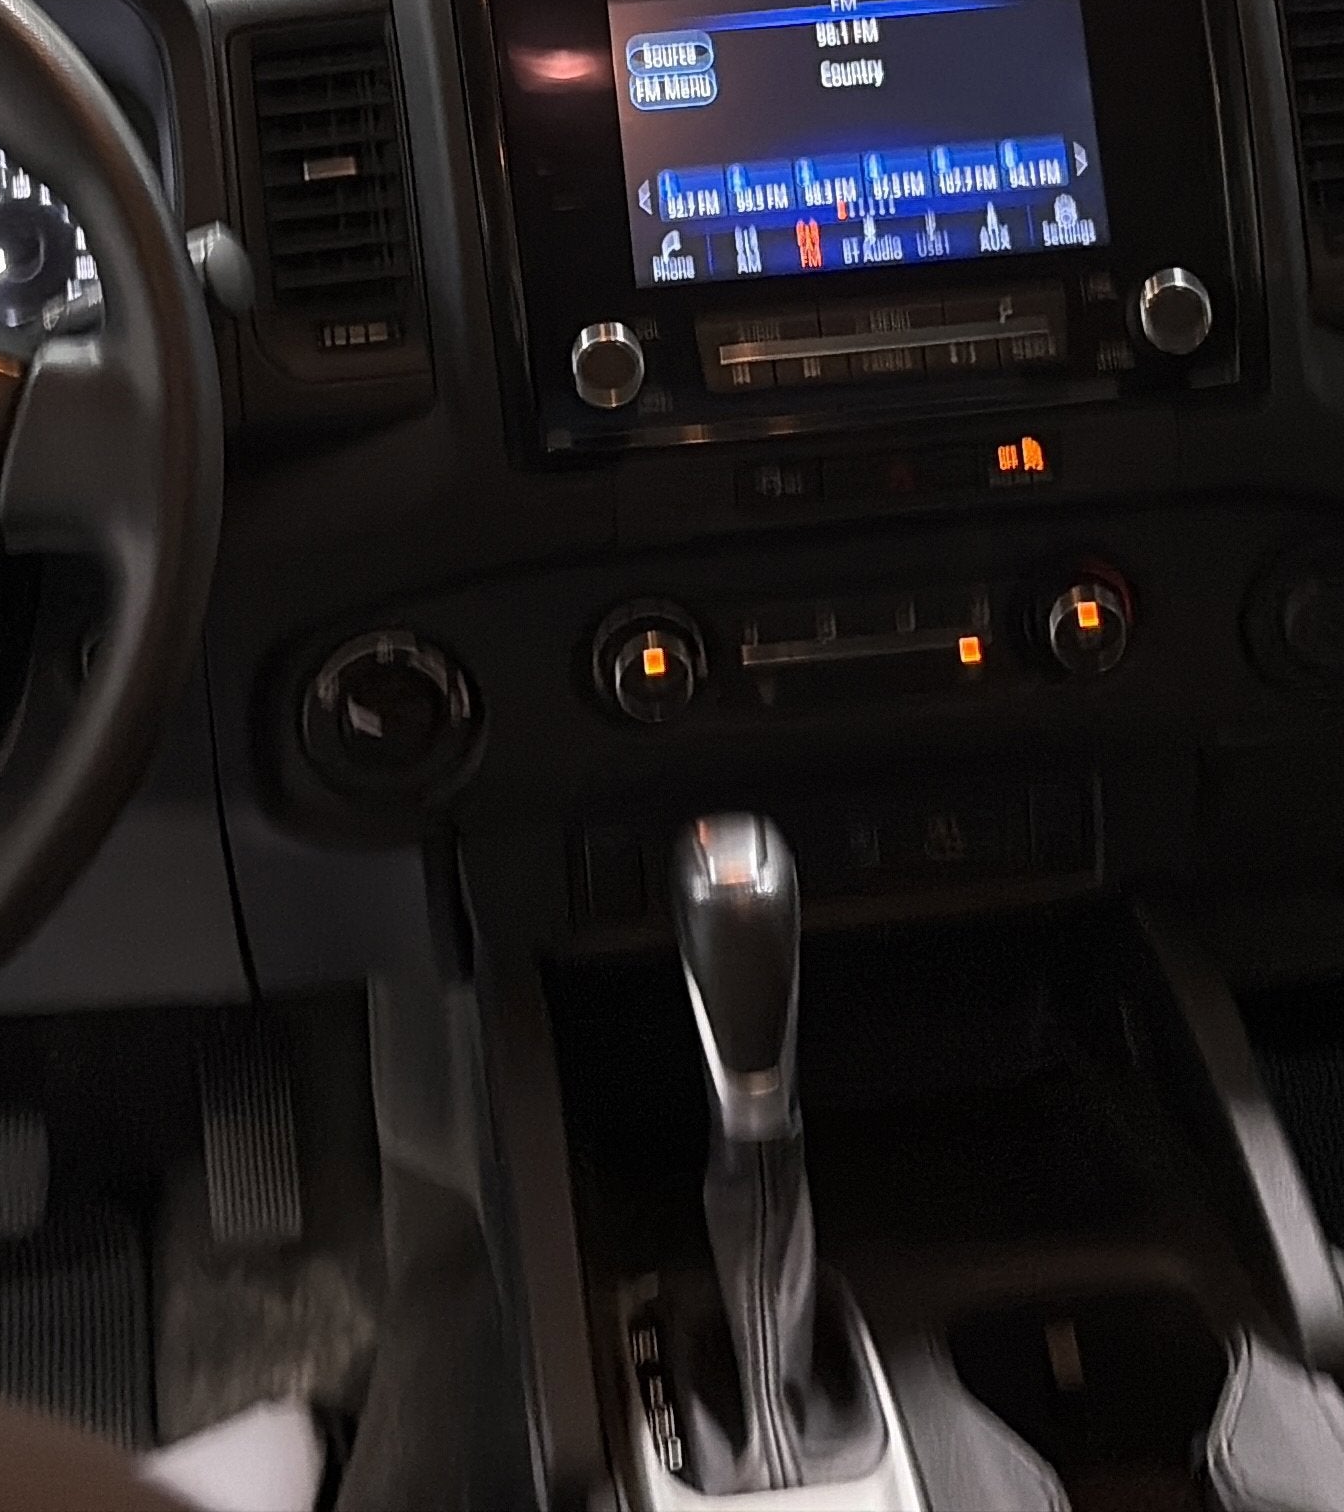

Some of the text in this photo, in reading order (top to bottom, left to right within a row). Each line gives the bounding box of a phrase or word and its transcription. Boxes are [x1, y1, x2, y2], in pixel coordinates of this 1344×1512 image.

[853, 16, 879, 44] FM
[642, 41, 698, 69] Source
[820, 58, 884, 88] Country
[635, 72, 711, 103] FM Menu
[903, 170, 925, 197] FM
[975, 164, 998, 192] FM
[1038, 158, 1061, 185] FM
[697, 188, 721, 217] FM
[766, 182, 789, 210] FM
[834, 177, 857, 203] FM
[979, 225, 1012, 253] AUX
[1042, 218, 1097, 248] Settings
[842, 236, 903, 265] BT Audio
[652, 254, 696, 283] Phone
